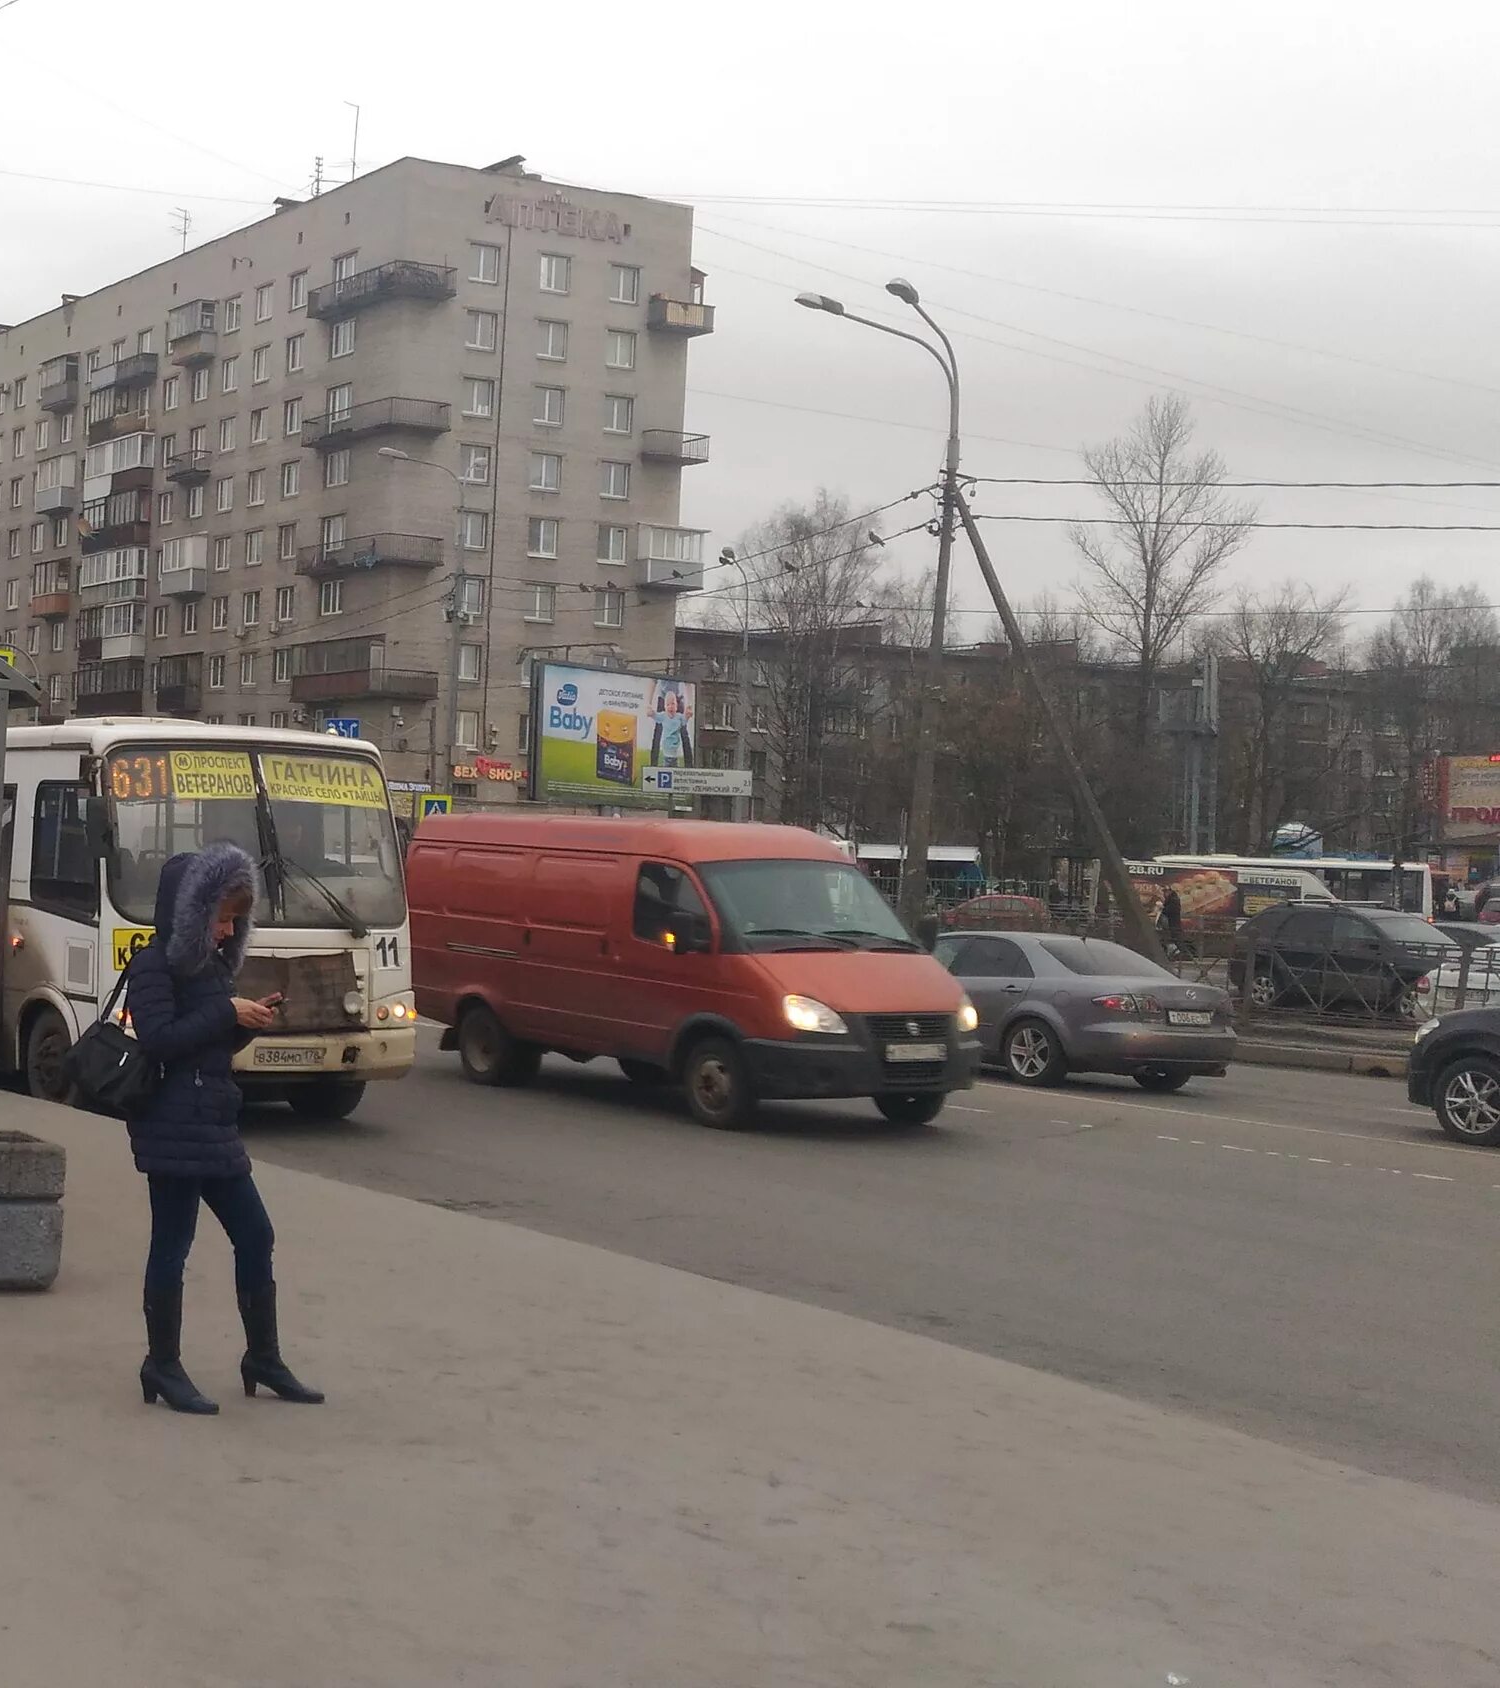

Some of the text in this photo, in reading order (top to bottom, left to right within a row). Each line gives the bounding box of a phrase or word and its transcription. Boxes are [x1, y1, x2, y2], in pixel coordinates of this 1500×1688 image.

[485, 193, 622, 245] АПТЕКА
[549, 705, 593, 739] Baby
[193, 755, 247, 770] ПРОСПЕКТ
[271, 760, 375, 788] ГАТЧИНА
[453, 765, 479, 779] SEX
[488, 768, 523, 781] SHOP
[604, 753, 623, 771] Baby
[112, 756, 168, 799] 631
[176, 773, 253, 795] ВЕТЕРАНОВ
[270, 783, 315, 798] КРАСНОЕ
[316, 786, 341, 801] СЕЛО
[376, 936, 401, 968] 11
